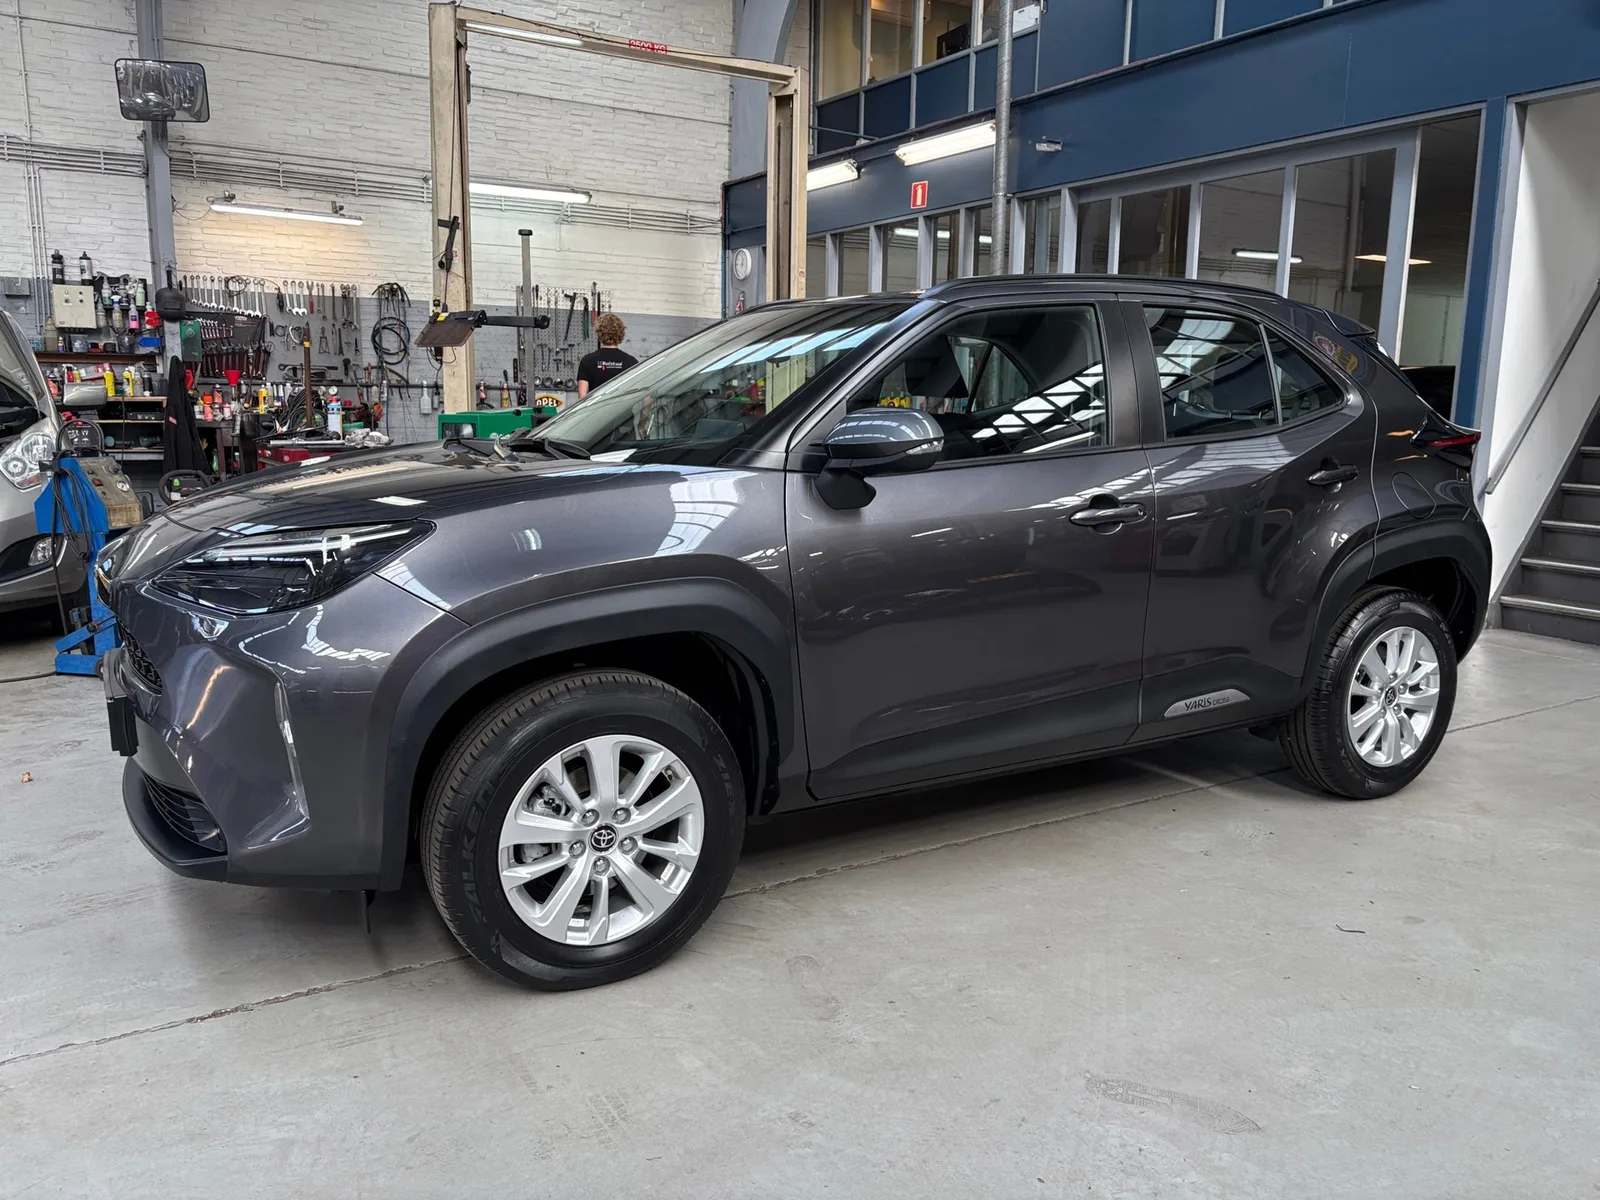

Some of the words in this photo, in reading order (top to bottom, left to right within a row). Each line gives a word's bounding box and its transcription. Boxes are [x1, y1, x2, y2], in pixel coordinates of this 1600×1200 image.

[630, 40, 652, 51] 2500
[654, 44, 666, 54] KG
[536, 397, 558, 407] OPEL
[1212, 696, 1231, 706] CROSS
